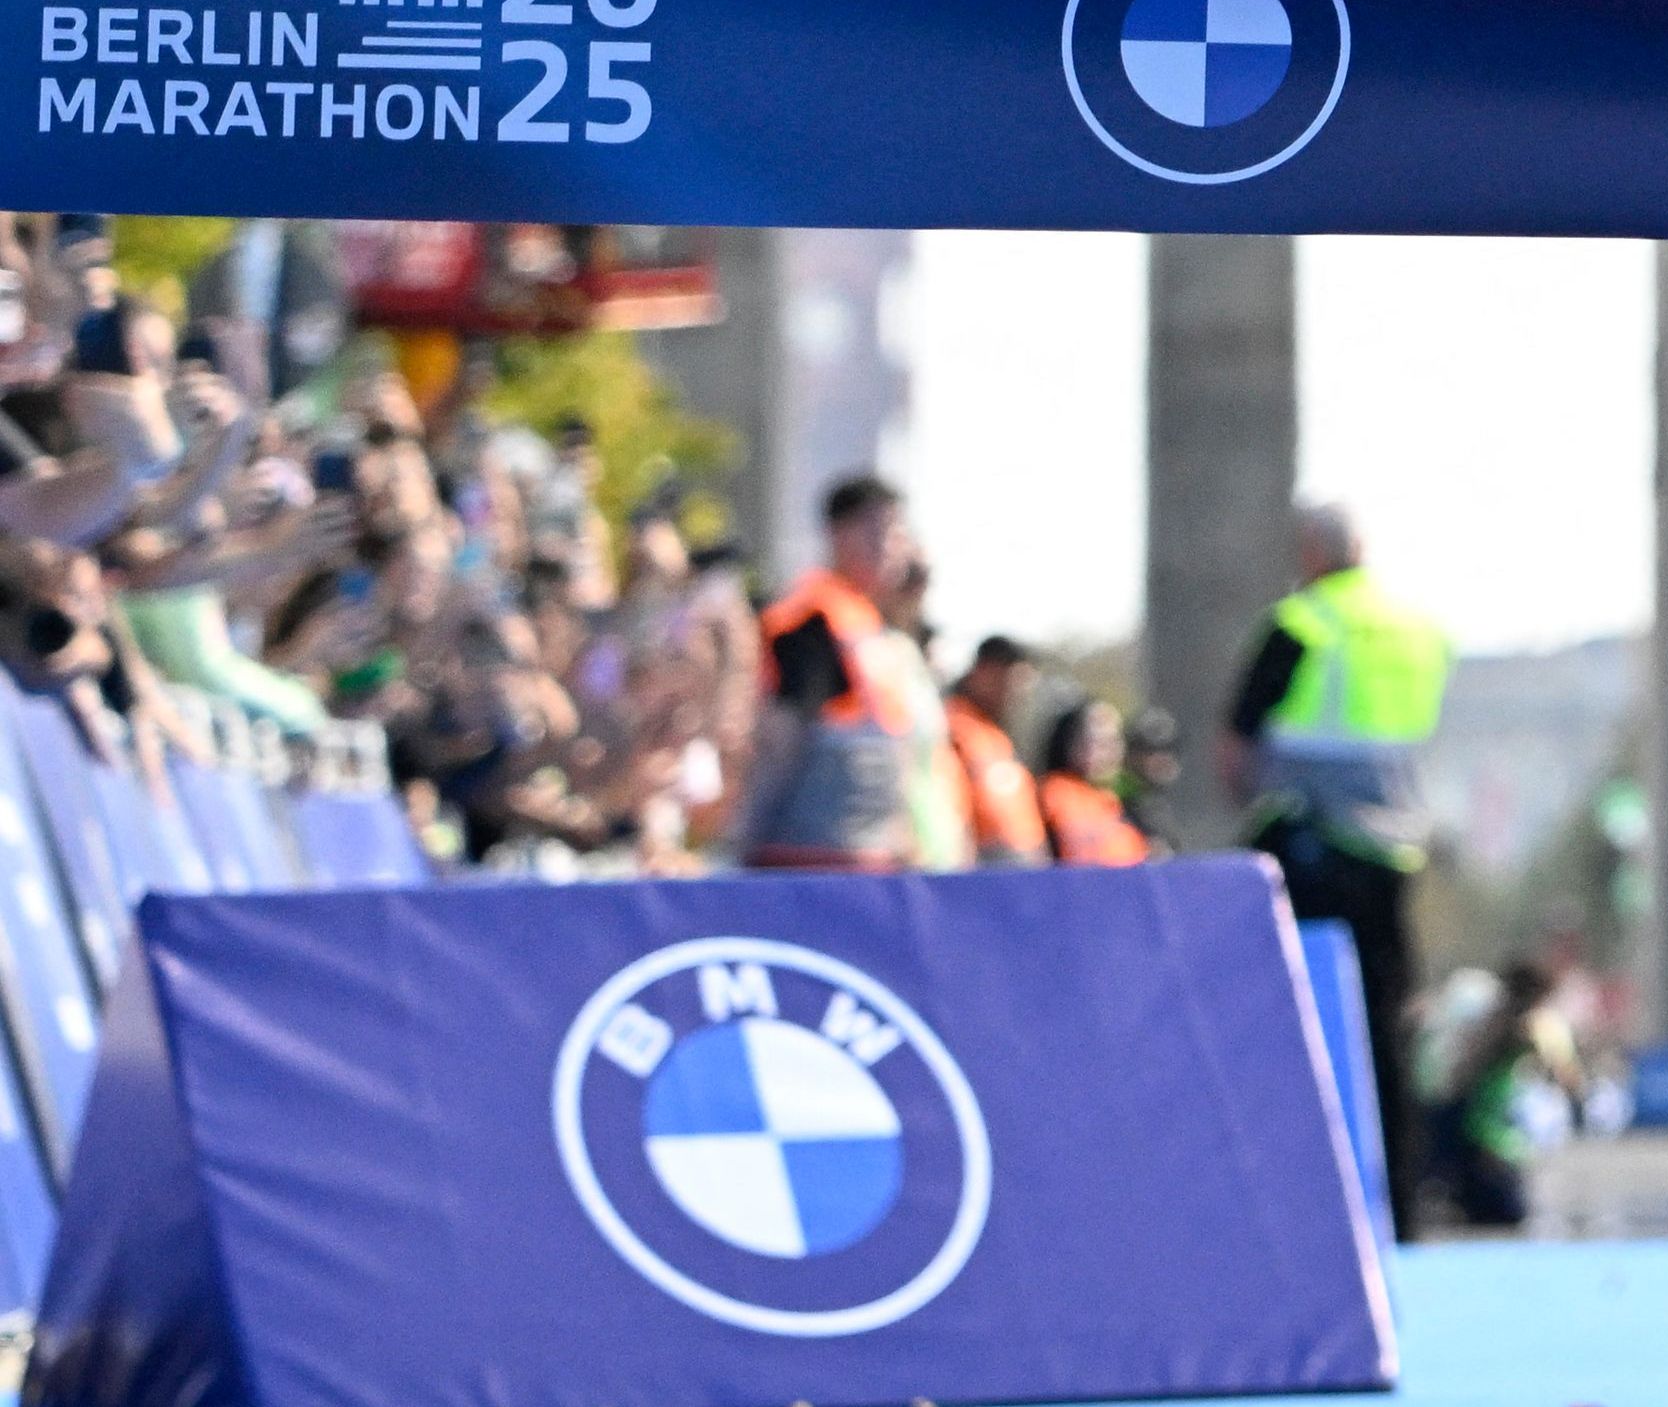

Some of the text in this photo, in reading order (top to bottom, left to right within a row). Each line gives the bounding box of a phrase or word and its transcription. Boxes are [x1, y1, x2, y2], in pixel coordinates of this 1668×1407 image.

[41, 7, 319, 67] BERLIN
[38, 77, 480, 141] MARATHON
[497, 40, 652, 144] 25
[598, 962, 903, 1078] BMW
